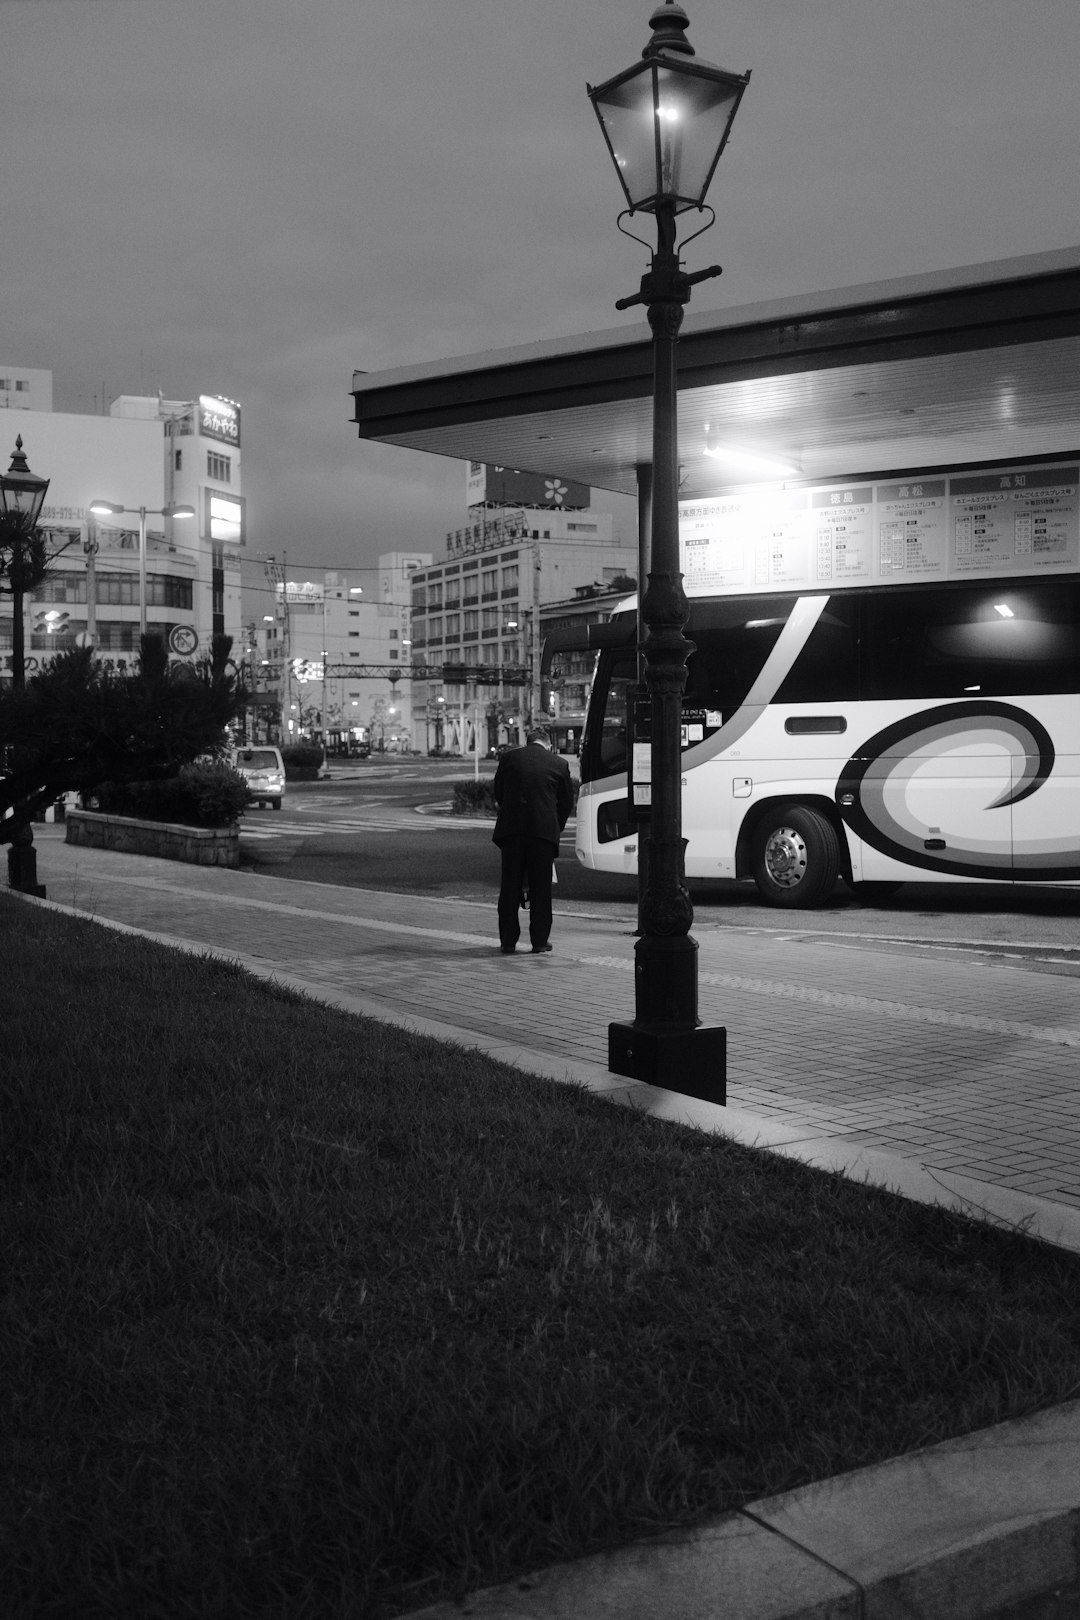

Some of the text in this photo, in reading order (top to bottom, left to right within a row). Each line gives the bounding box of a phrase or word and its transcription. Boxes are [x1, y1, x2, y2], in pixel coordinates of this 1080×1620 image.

[1000, 475, 1026, 488] 高知
[830, 492, 854, 504] 徳島
[898, 485, 923, 498] 高松
